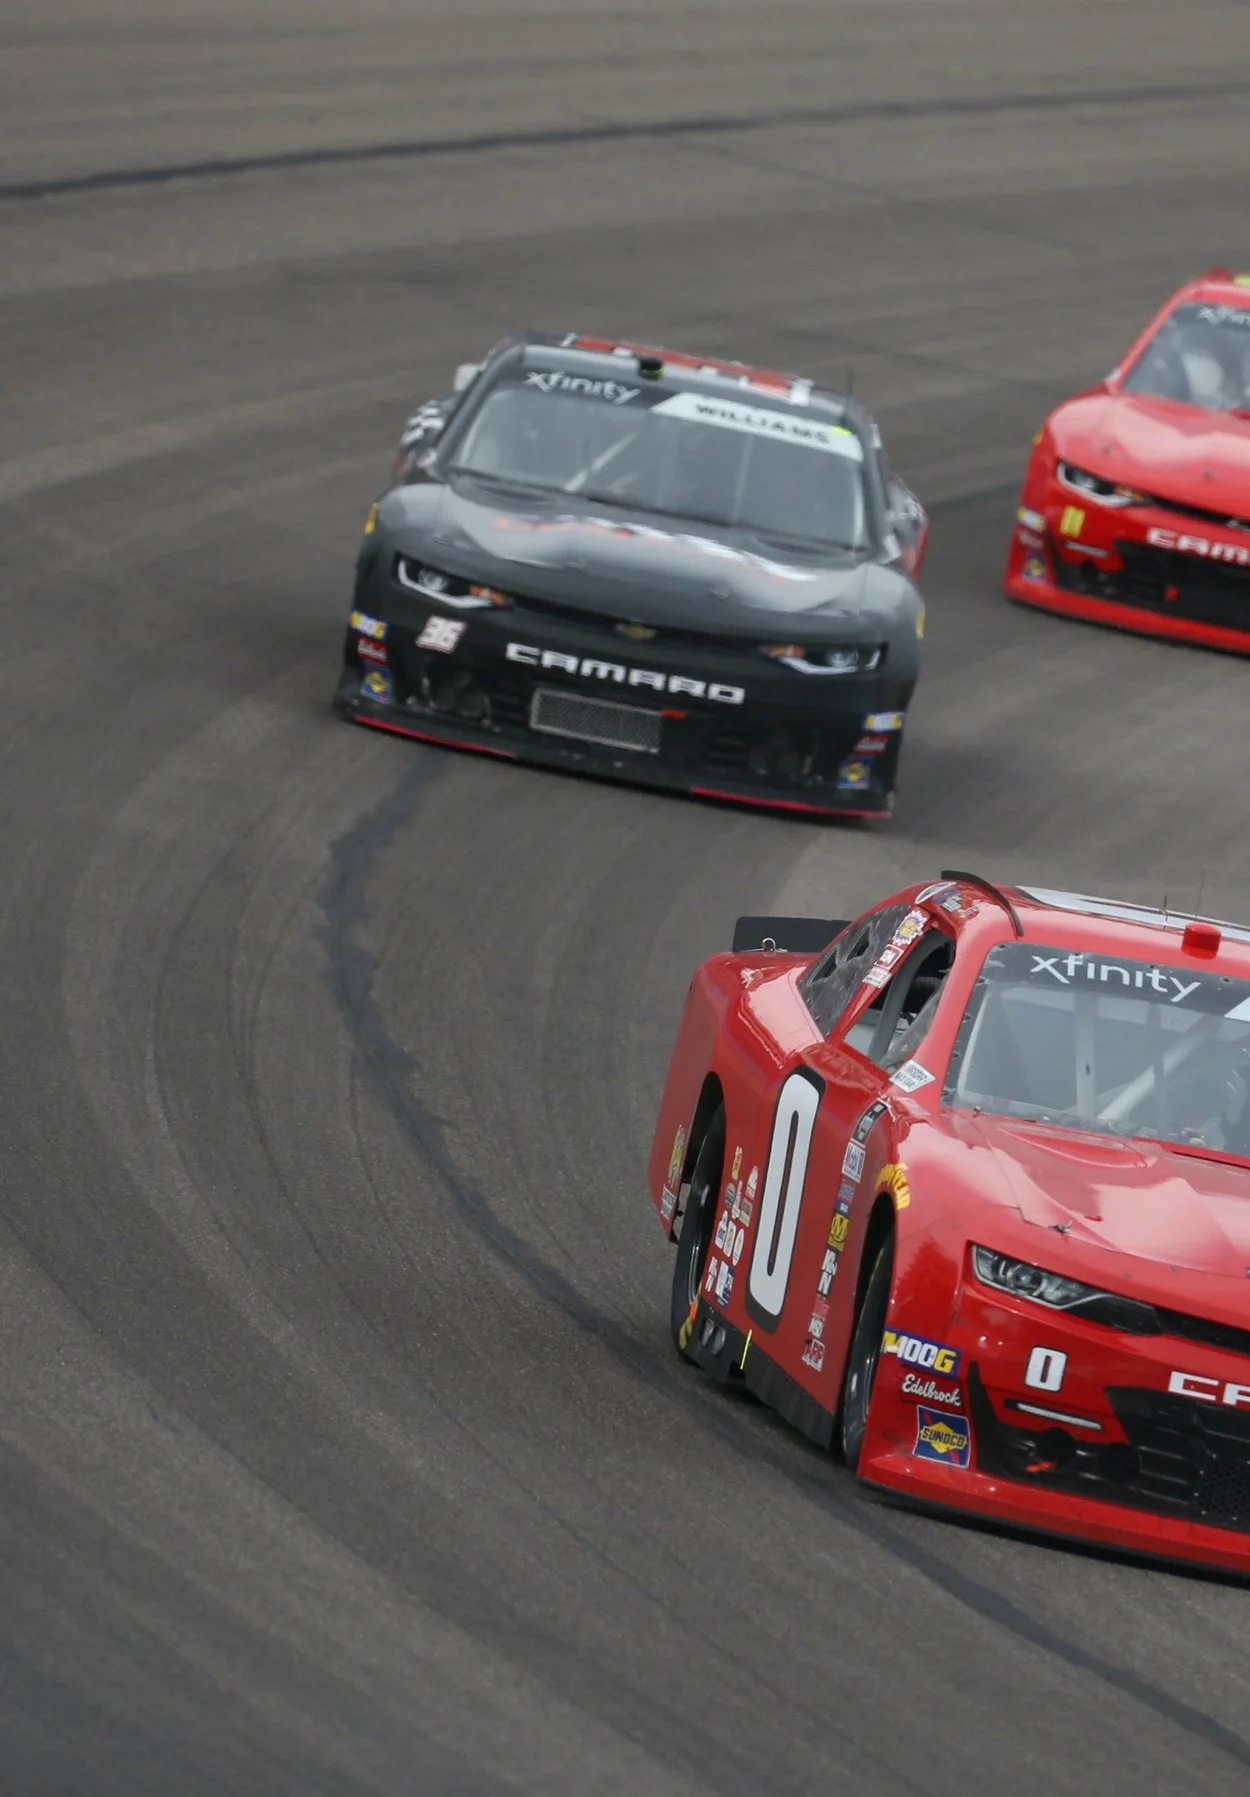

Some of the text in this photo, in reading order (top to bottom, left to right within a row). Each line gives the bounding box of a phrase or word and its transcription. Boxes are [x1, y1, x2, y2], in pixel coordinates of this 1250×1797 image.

[525, 370, 641, 404] xfinity
[696, 402, 831, 445] WILLIAMS
[505, 642, 745, 704] CAMARO
[1030, 953, 1201, 1002] xfinity
[748, 1073, 821, 1316] 0
[880, 1331, 957, 1373] MOOG
[1025, 1346, 1067, 1391] 0
[902, 1373, 962, 1406] Edelbrock
[921, 1427, 966, 1448] SUNOCO
